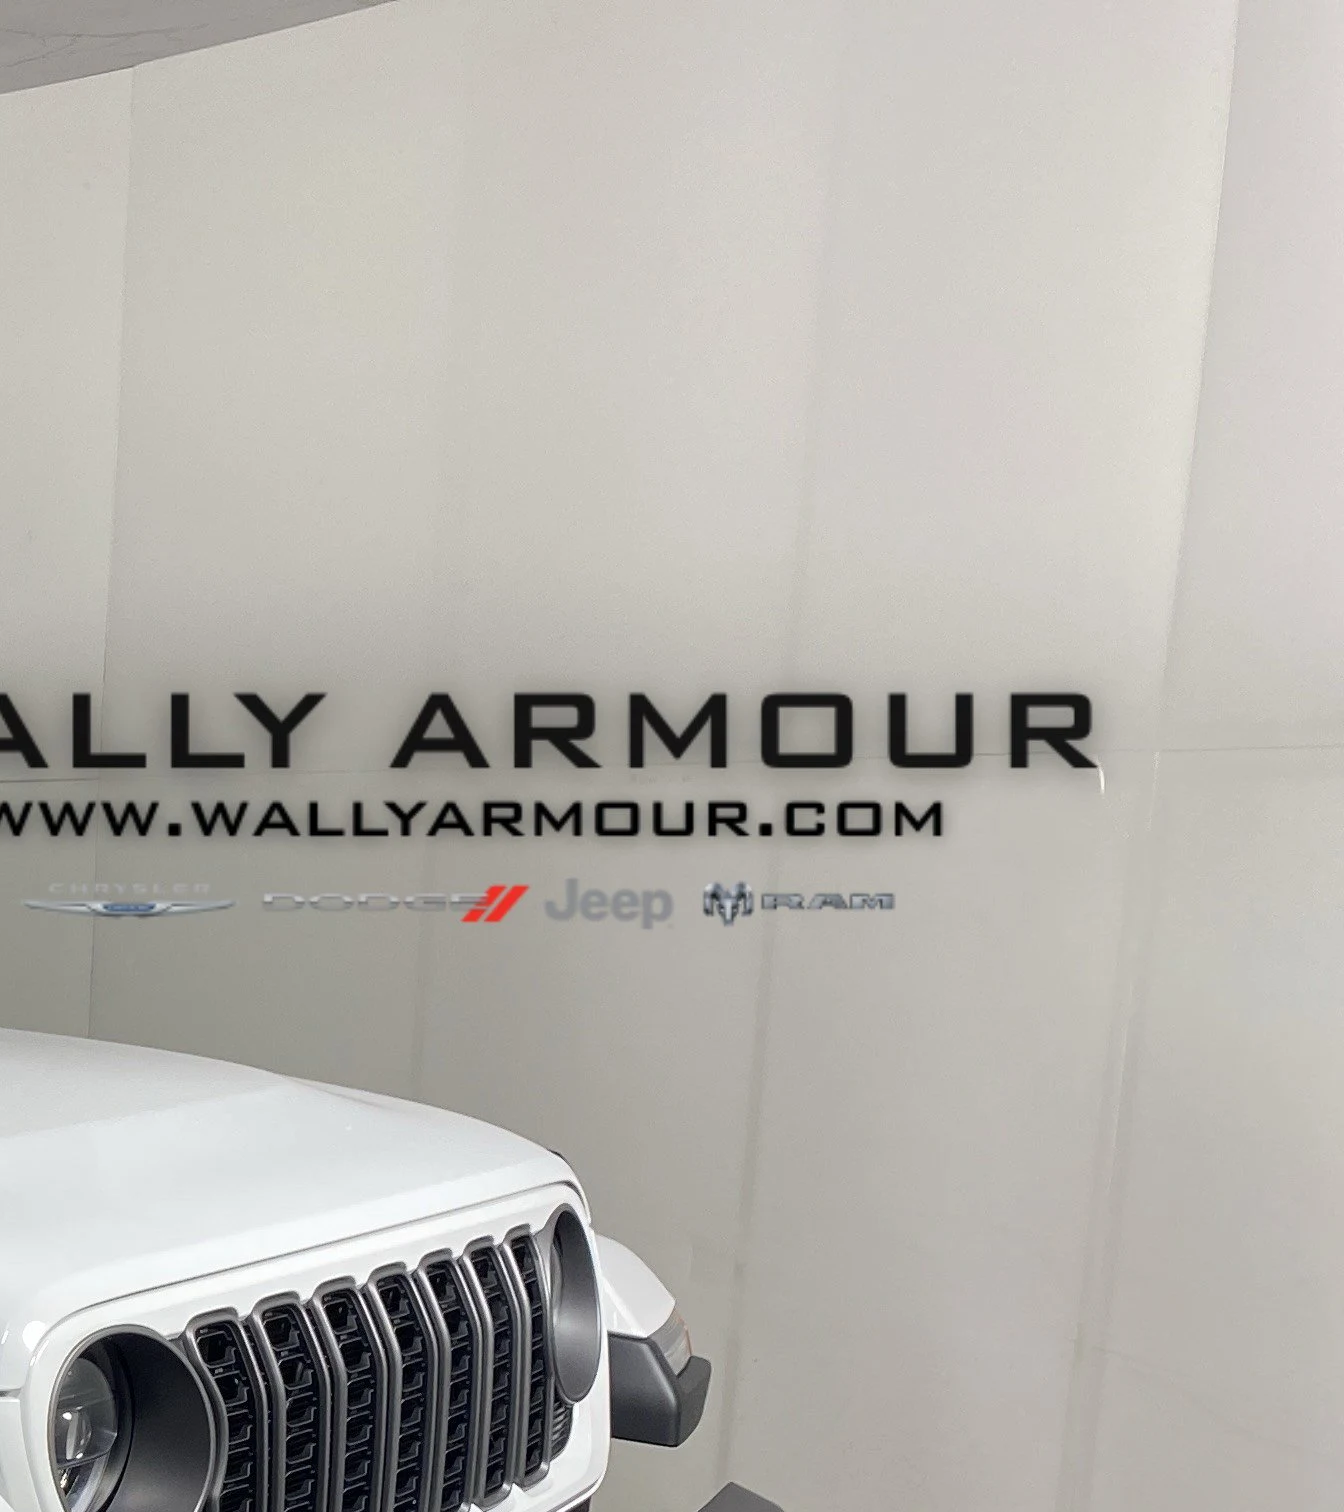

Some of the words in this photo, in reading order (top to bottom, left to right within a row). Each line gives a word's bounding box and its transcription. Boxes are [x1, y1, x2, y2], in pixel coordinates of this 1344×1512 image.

[388, 692, 1099, 769] ARMOUR
[47, 882, 212, 894] CHRYSLER
[262, 892, 489, 913] DODGE
[544, 878, 674, 930] Jeep
[761, 893, 897, 911] RAM
